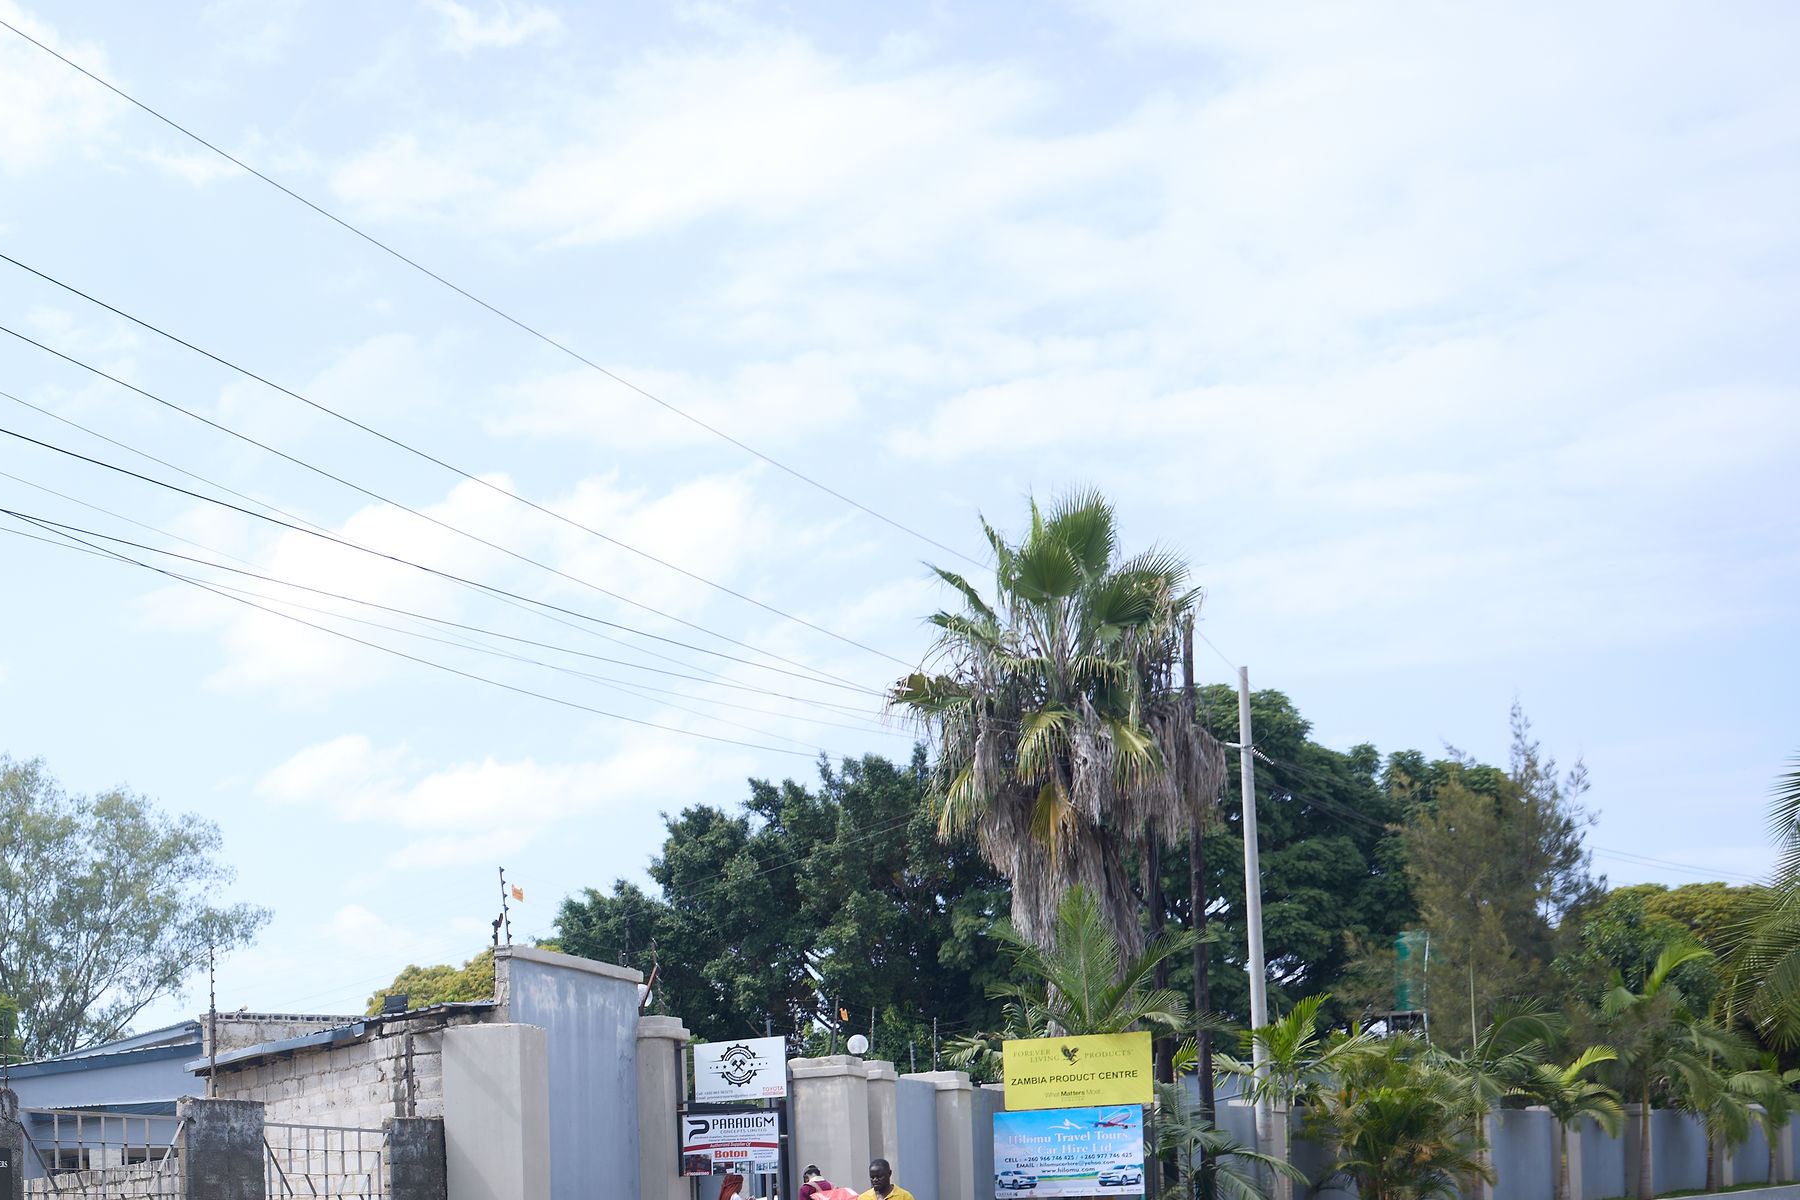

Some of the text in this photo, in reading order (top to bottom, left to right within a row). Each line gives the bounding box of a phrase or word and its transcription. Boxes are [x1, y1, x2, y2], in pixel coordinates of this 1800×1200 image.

[1013, 1049, 1132, 1059] FOREVER PRODUCTS
[1030, 1055, 1060, 1063] LIVING
[1011, 1069, 1138, 1086] ZAMBIA PRODUCT CENTRE
[712, 1116, 775, 1129] PARADIGM
[1008, 1130, 1128, 1145] Hilomu Travel Tours
[714, 1150, 748, 1158] Boton
[1037, 1145, 1058, 1155] Car
[1061, 1144, 1090, 1154] Hire
[1092, 1142, 1112, 1153] Ltd
[1041, 1166, 1095, 1174] www.hilomu.com
